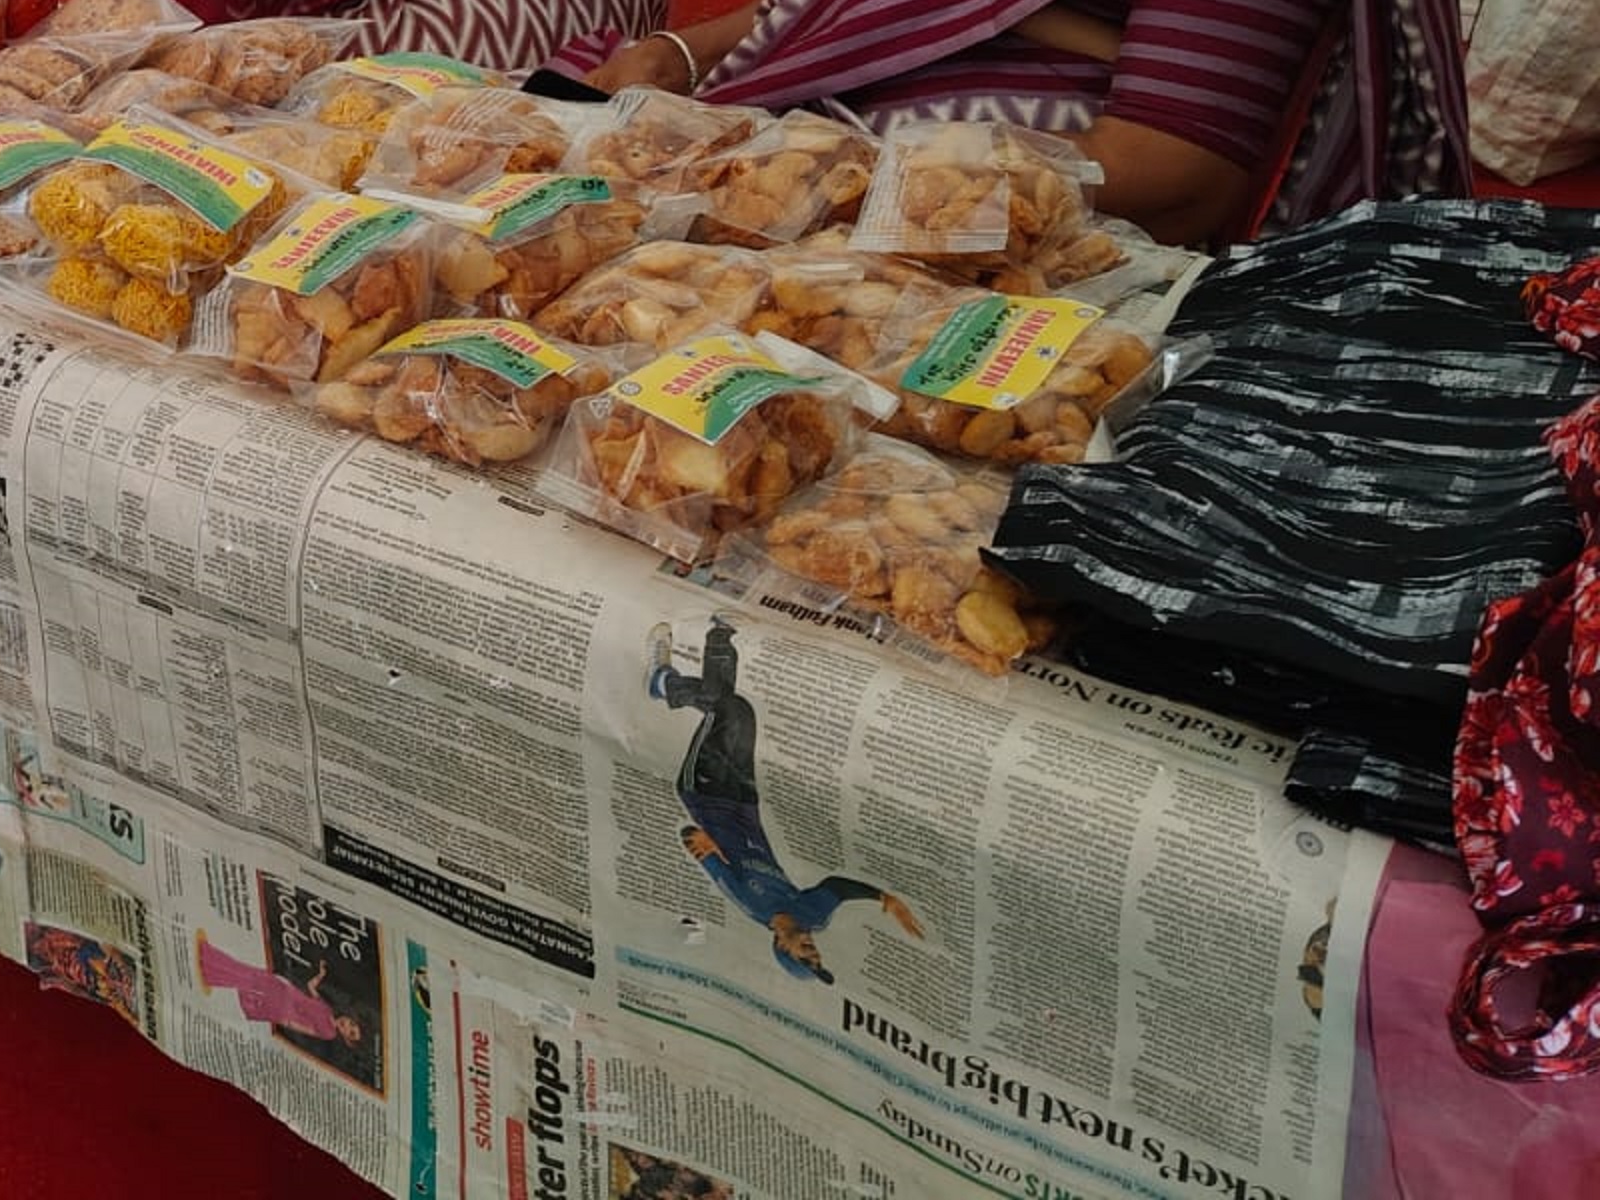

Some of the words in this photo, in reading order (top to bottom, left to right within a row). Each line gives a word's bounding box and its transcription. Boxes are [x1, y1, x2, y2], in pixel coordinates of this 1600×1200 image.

[127, 129, 238, 188] SANJEEVINI
[270, 206, 360, 271] SANJEEVINI
[975, 309, 1056, 389] SANJEEVINI
[759, 594, 833, 632] Fulham
[1105, 689, 1152, 717] on
[470, 1030, 493, 1153] showtime
[527, 1035, 572, 1139] flops
[842, 999, 957, 1089] brand
[960, 1054, 1031, 1117] big
[1039, 1089, 1146, 1154] next
[875, 1098, 997, 1175] Sunday
[992, 1156, 1022, 1185] on
